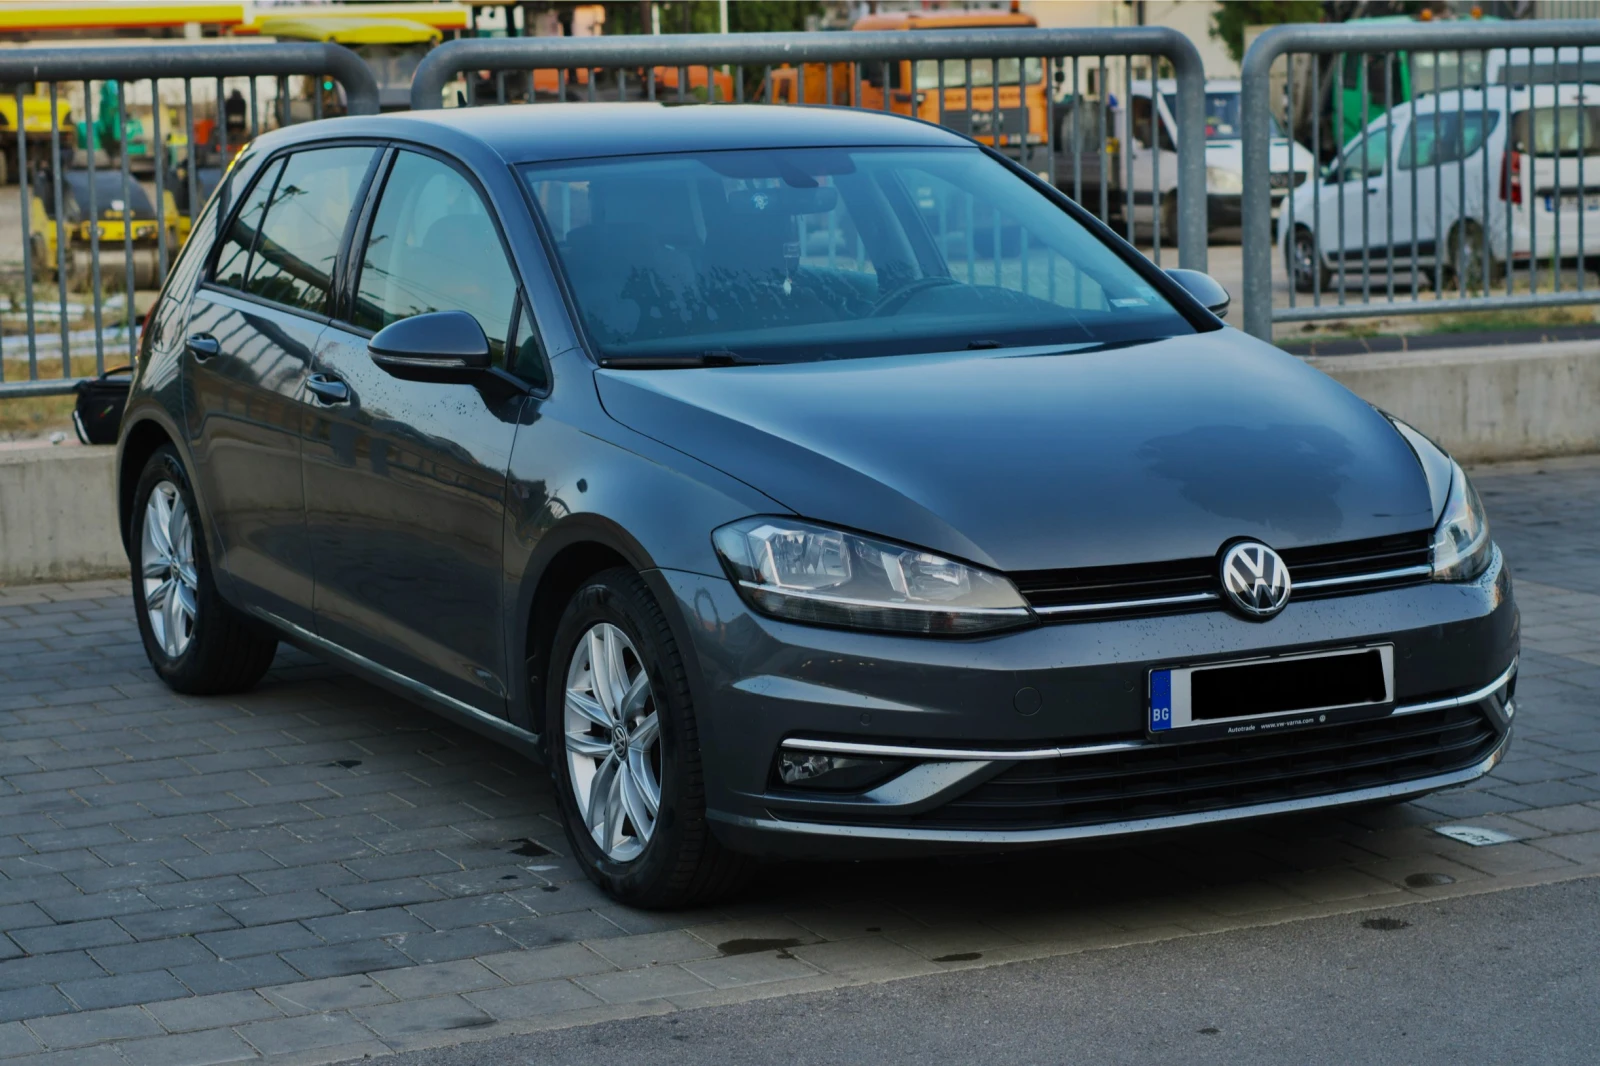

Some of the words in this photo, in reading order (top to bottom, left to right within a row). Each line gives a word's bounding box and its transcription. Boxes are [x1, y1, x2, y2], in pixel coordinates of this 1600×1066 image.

[1224, 542, 1291, 613] VW
[1153, 707, 1169, 722] BG
[1227, 725, 1256, 733] Autotrade
[1260, 718, 1314, 729] www.vw-varna.com
